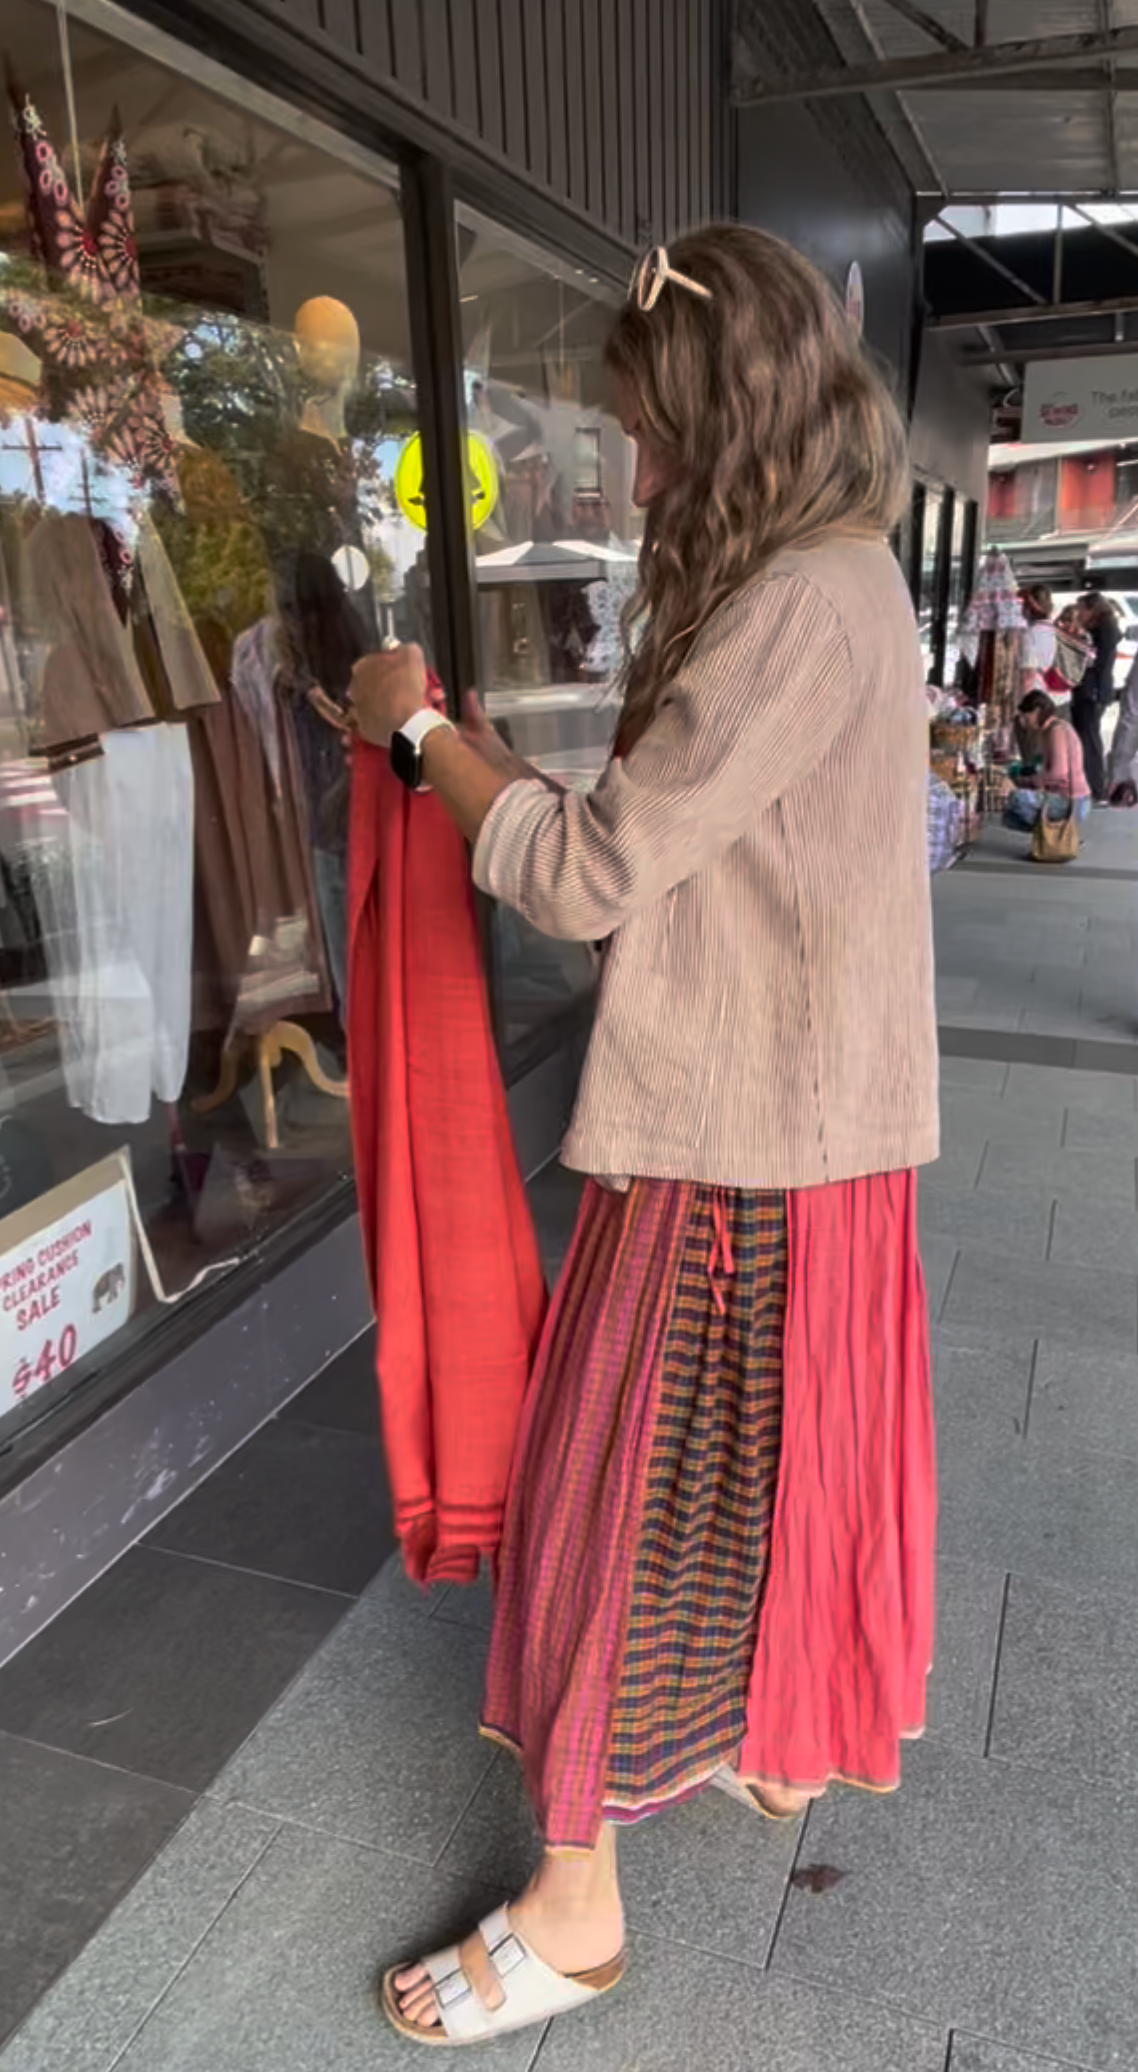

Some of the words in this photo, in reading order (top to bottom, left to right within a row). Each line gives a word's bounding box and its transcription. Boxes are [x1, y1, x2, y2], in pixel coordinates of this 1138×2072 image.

[0, 1257, 35, 1291] RING
[37, 1219, 92, 1266] CUSHION
[2, 1248, 79, 1312] CLEARANCE
[16, 1285, 60, 1331] SALE
[12, 1323, 78, 1399] $40
